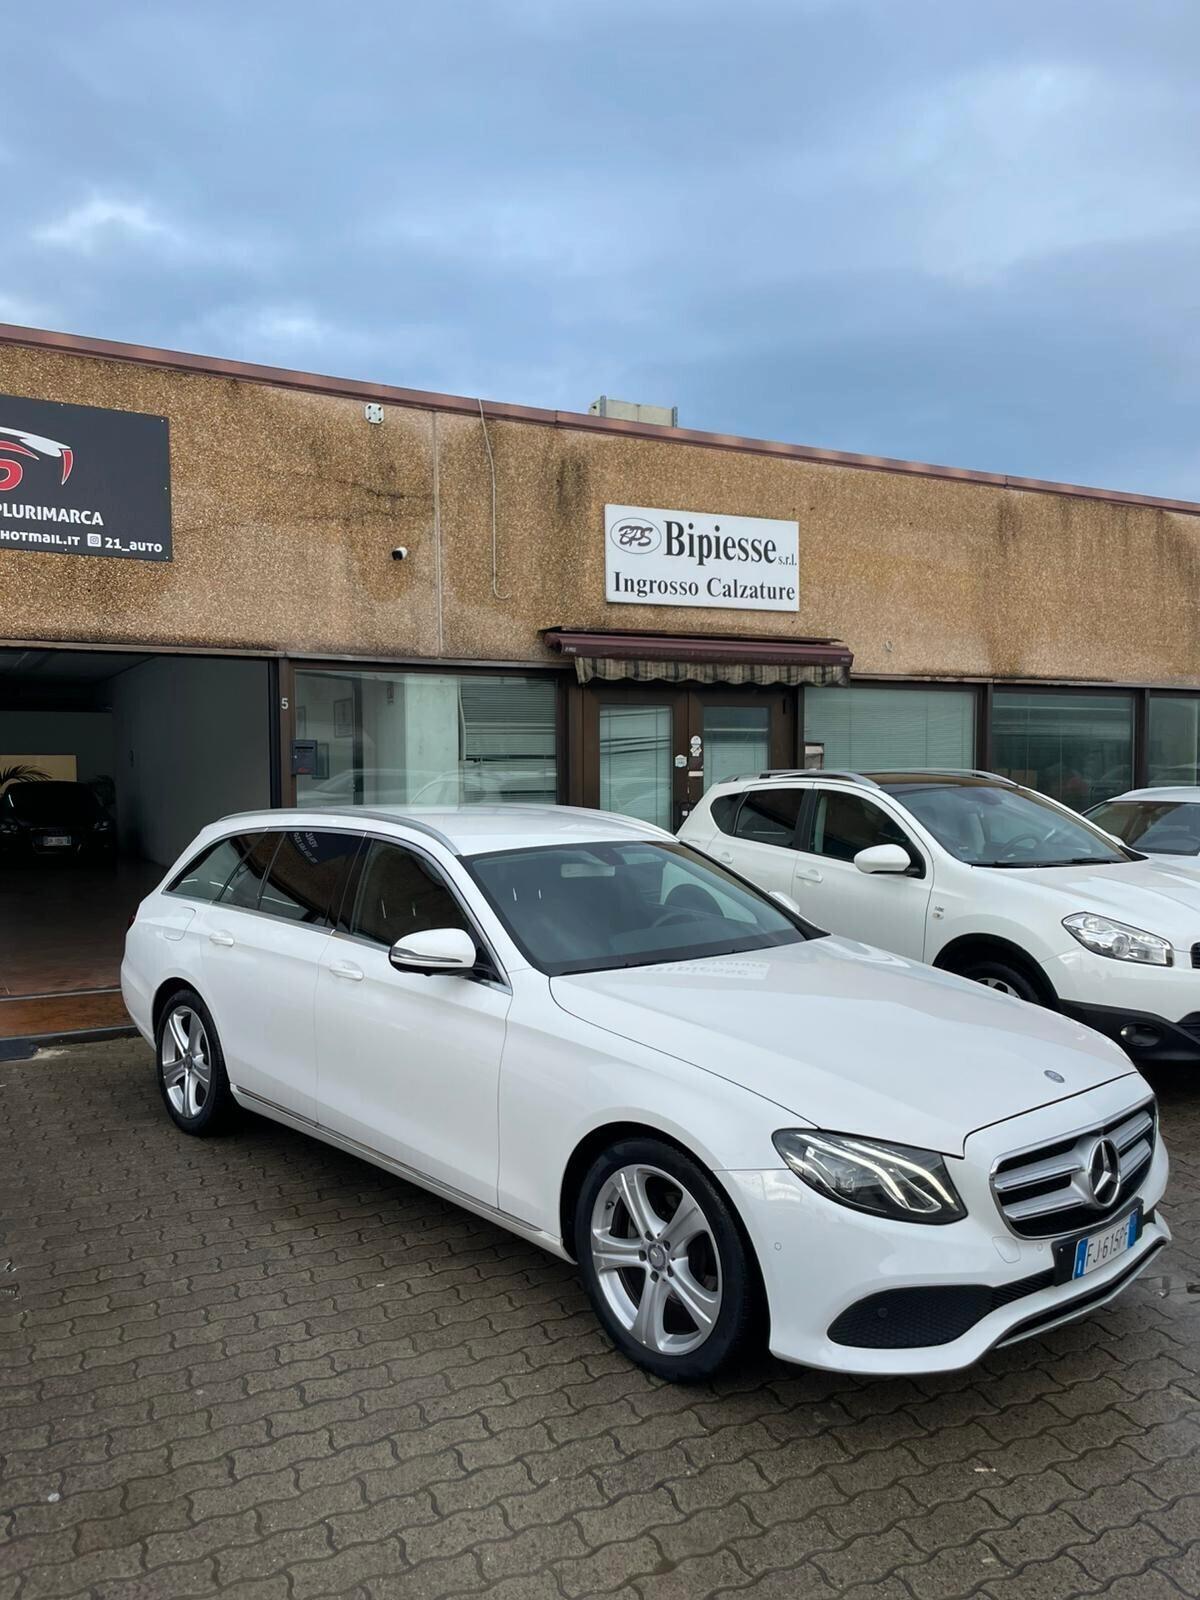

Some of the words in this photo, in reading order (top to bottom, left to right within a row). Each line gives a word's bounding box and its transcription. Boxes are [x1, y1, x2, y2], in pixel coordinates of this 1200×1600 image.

[0, 503, 104, 525] LURIMARCA
[664, 521, 777, 566] Bipiesse
[778, 553, 797, 566] s.r.l.
[614, 571, 699, 597] Ingrosso
[706, 577, 795, 600] Calzature
[281, 697, 289, 709] 5
